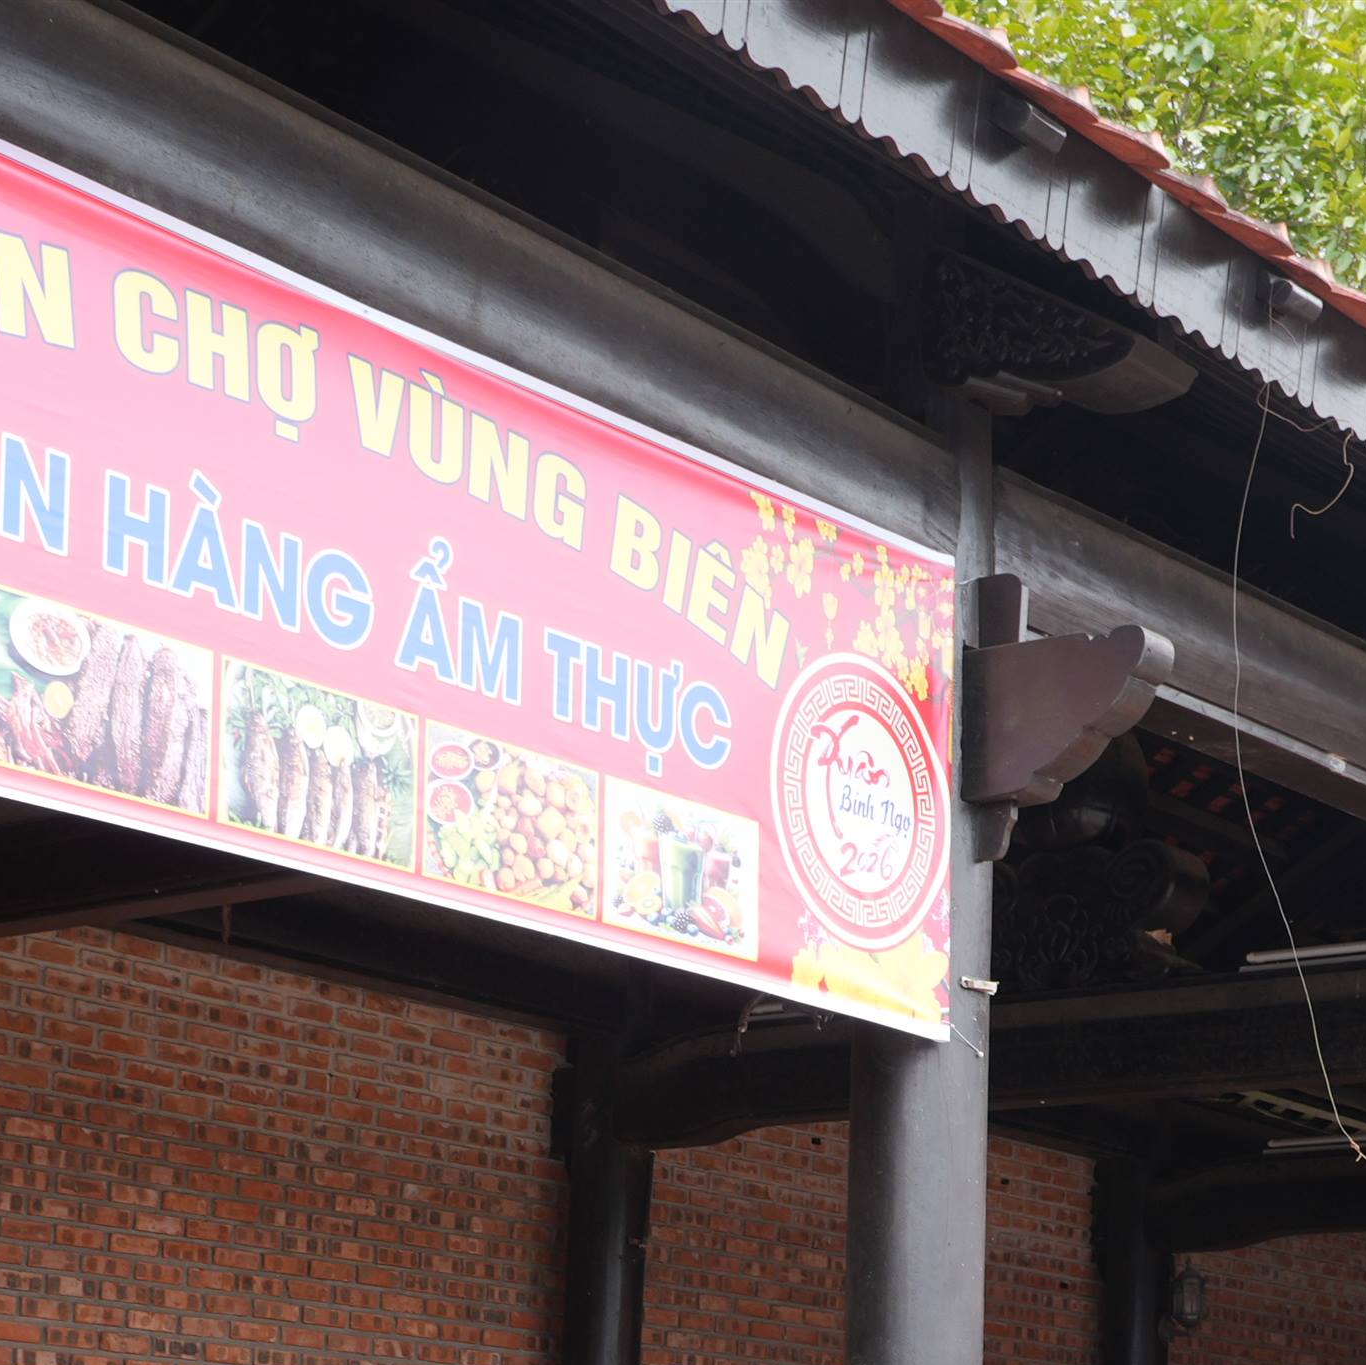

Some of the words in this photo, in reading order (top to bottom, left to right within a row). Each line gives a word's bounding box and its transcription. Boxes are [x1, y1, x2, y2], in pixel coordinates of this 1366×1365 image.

[102, 469, 376, 653] HÀNG
[394, 534, 524, 706] ẨM
[544, 629, 733, 777] THỰC
[112, 268, 320, 443] CHỢ
[346, 353, 588, 552] VÙNG
[610, 492, 790, 691] BIÊN
[881, 799, 911, 839] Ngọ
